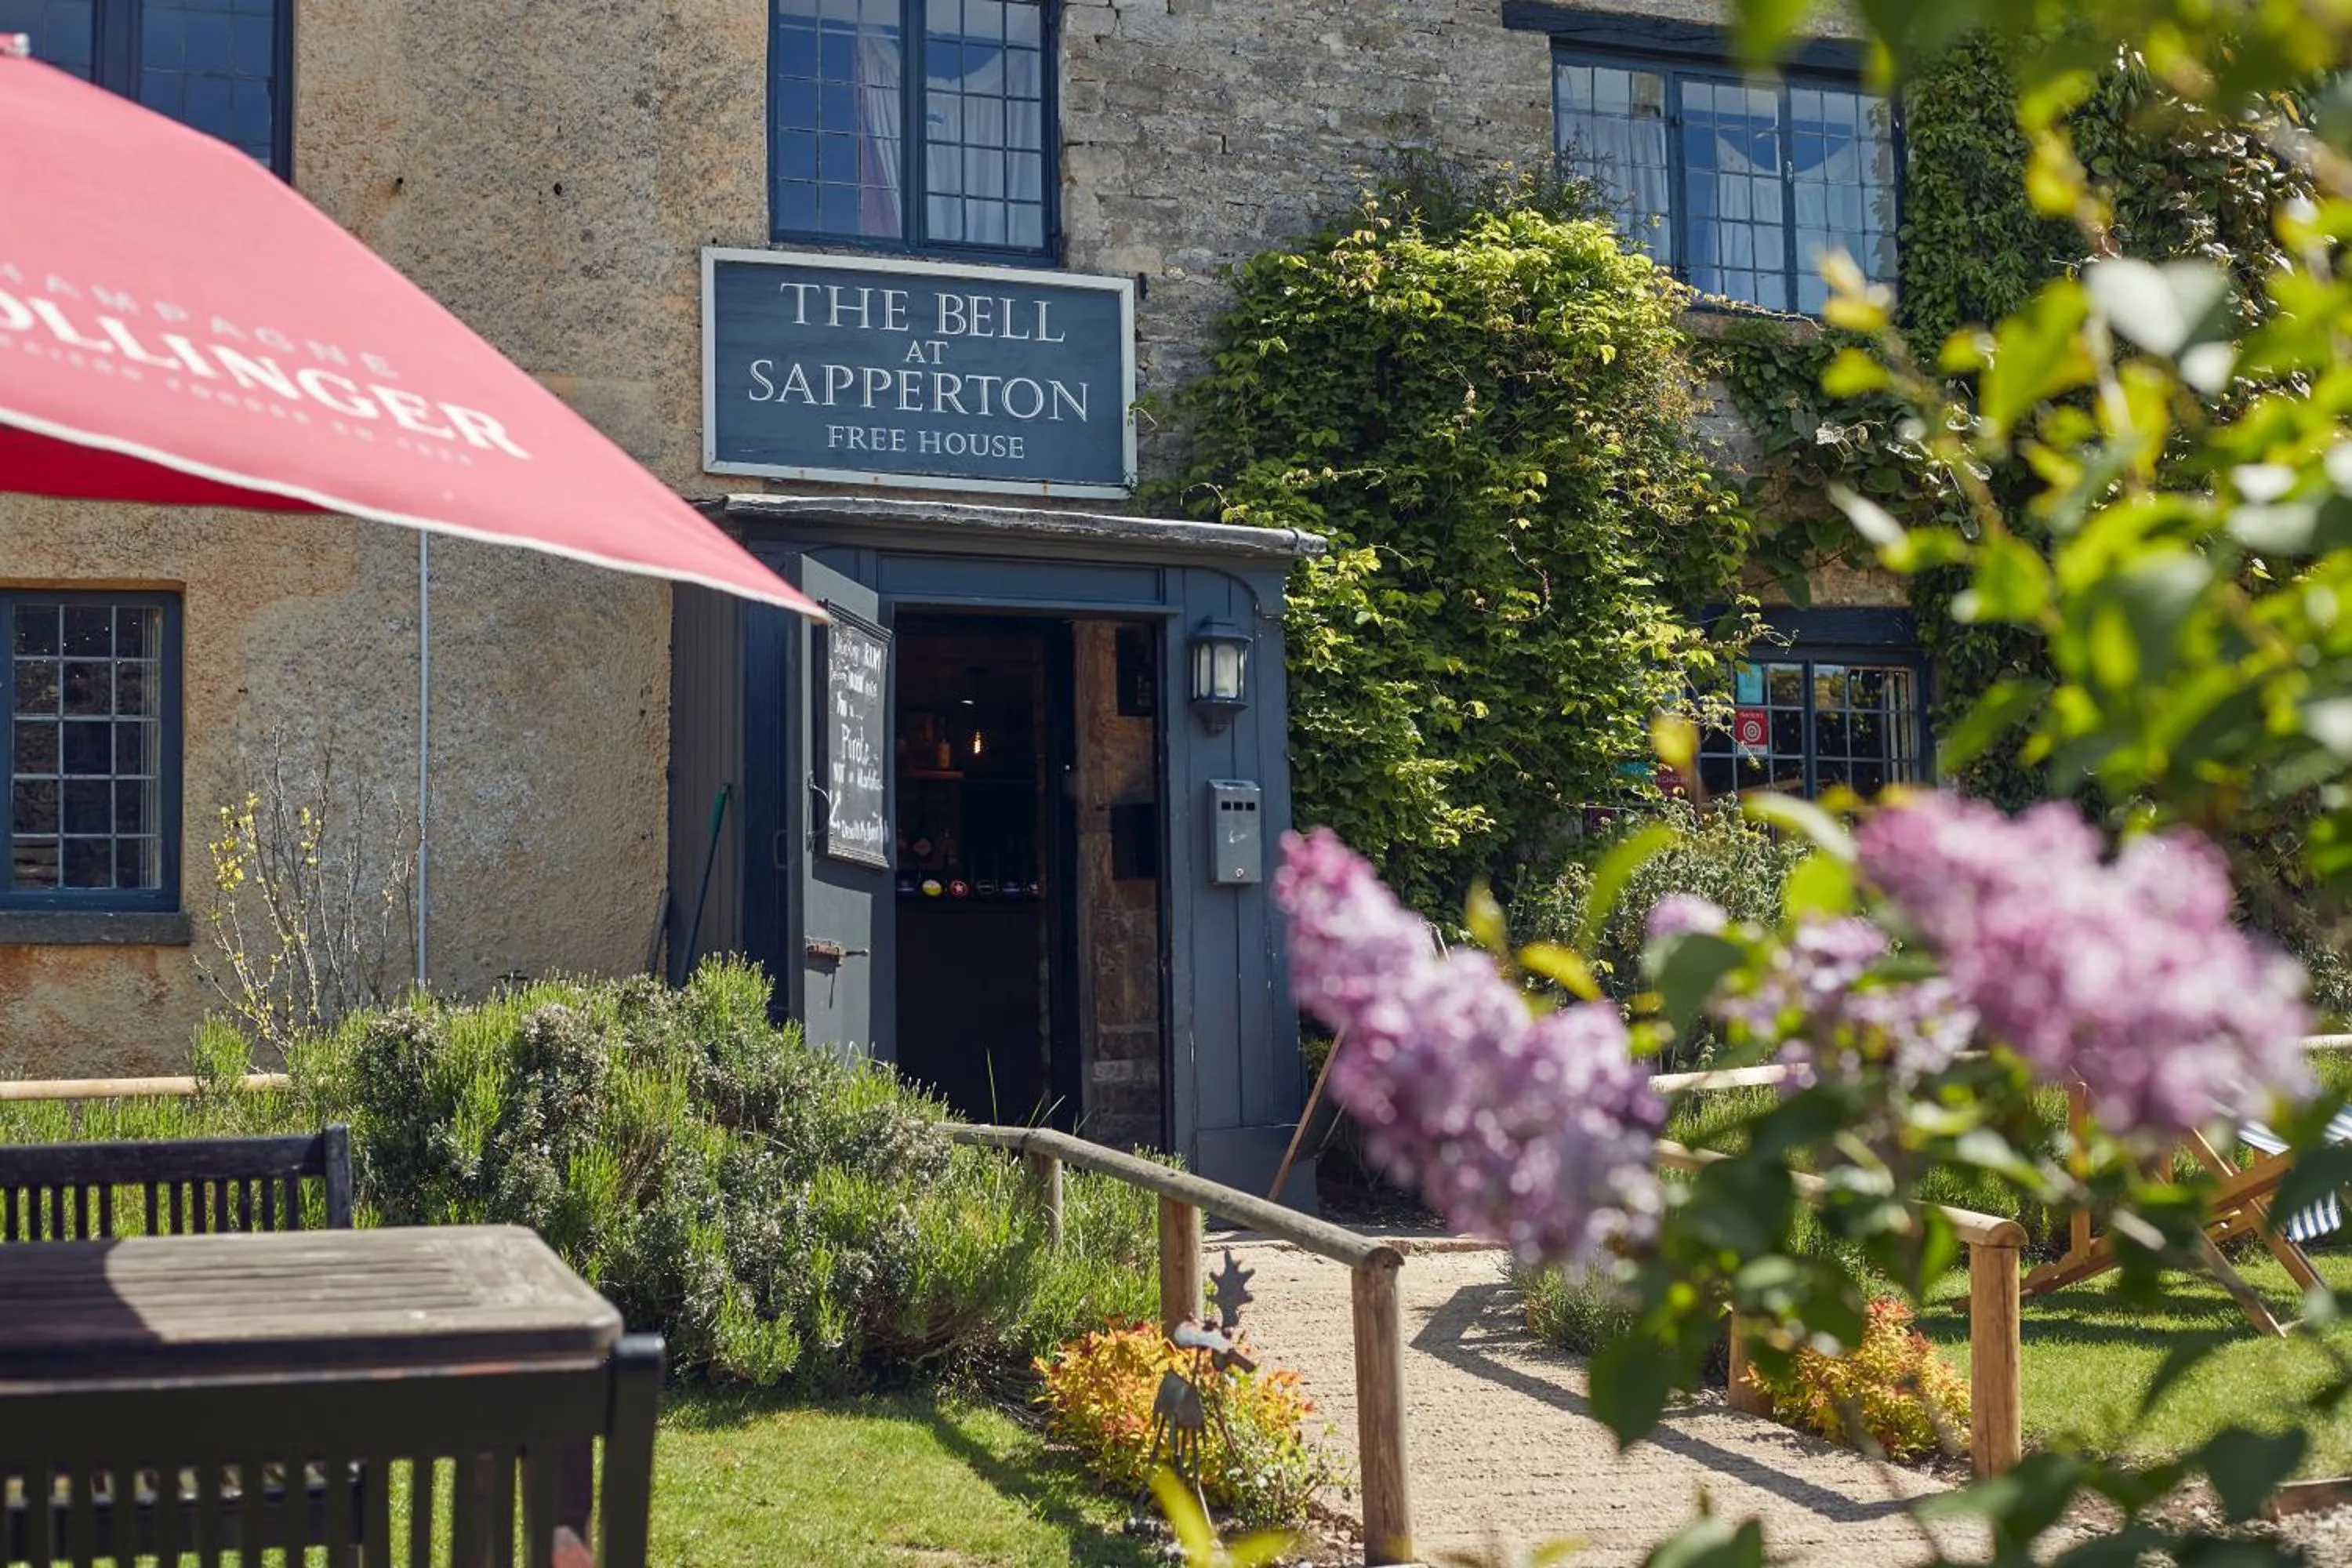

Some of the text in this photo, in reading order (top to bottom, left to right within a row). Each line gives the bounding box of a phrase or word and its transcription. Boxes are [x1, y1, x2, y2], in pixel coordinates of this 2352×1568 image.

[780, 282, 1066, 343] THE BELL
[905, 339, 949, 365] AT
[748, 359, 1091, 423] SAPPERTON
[826, 423, 1025, 459] FREE HOUSE
